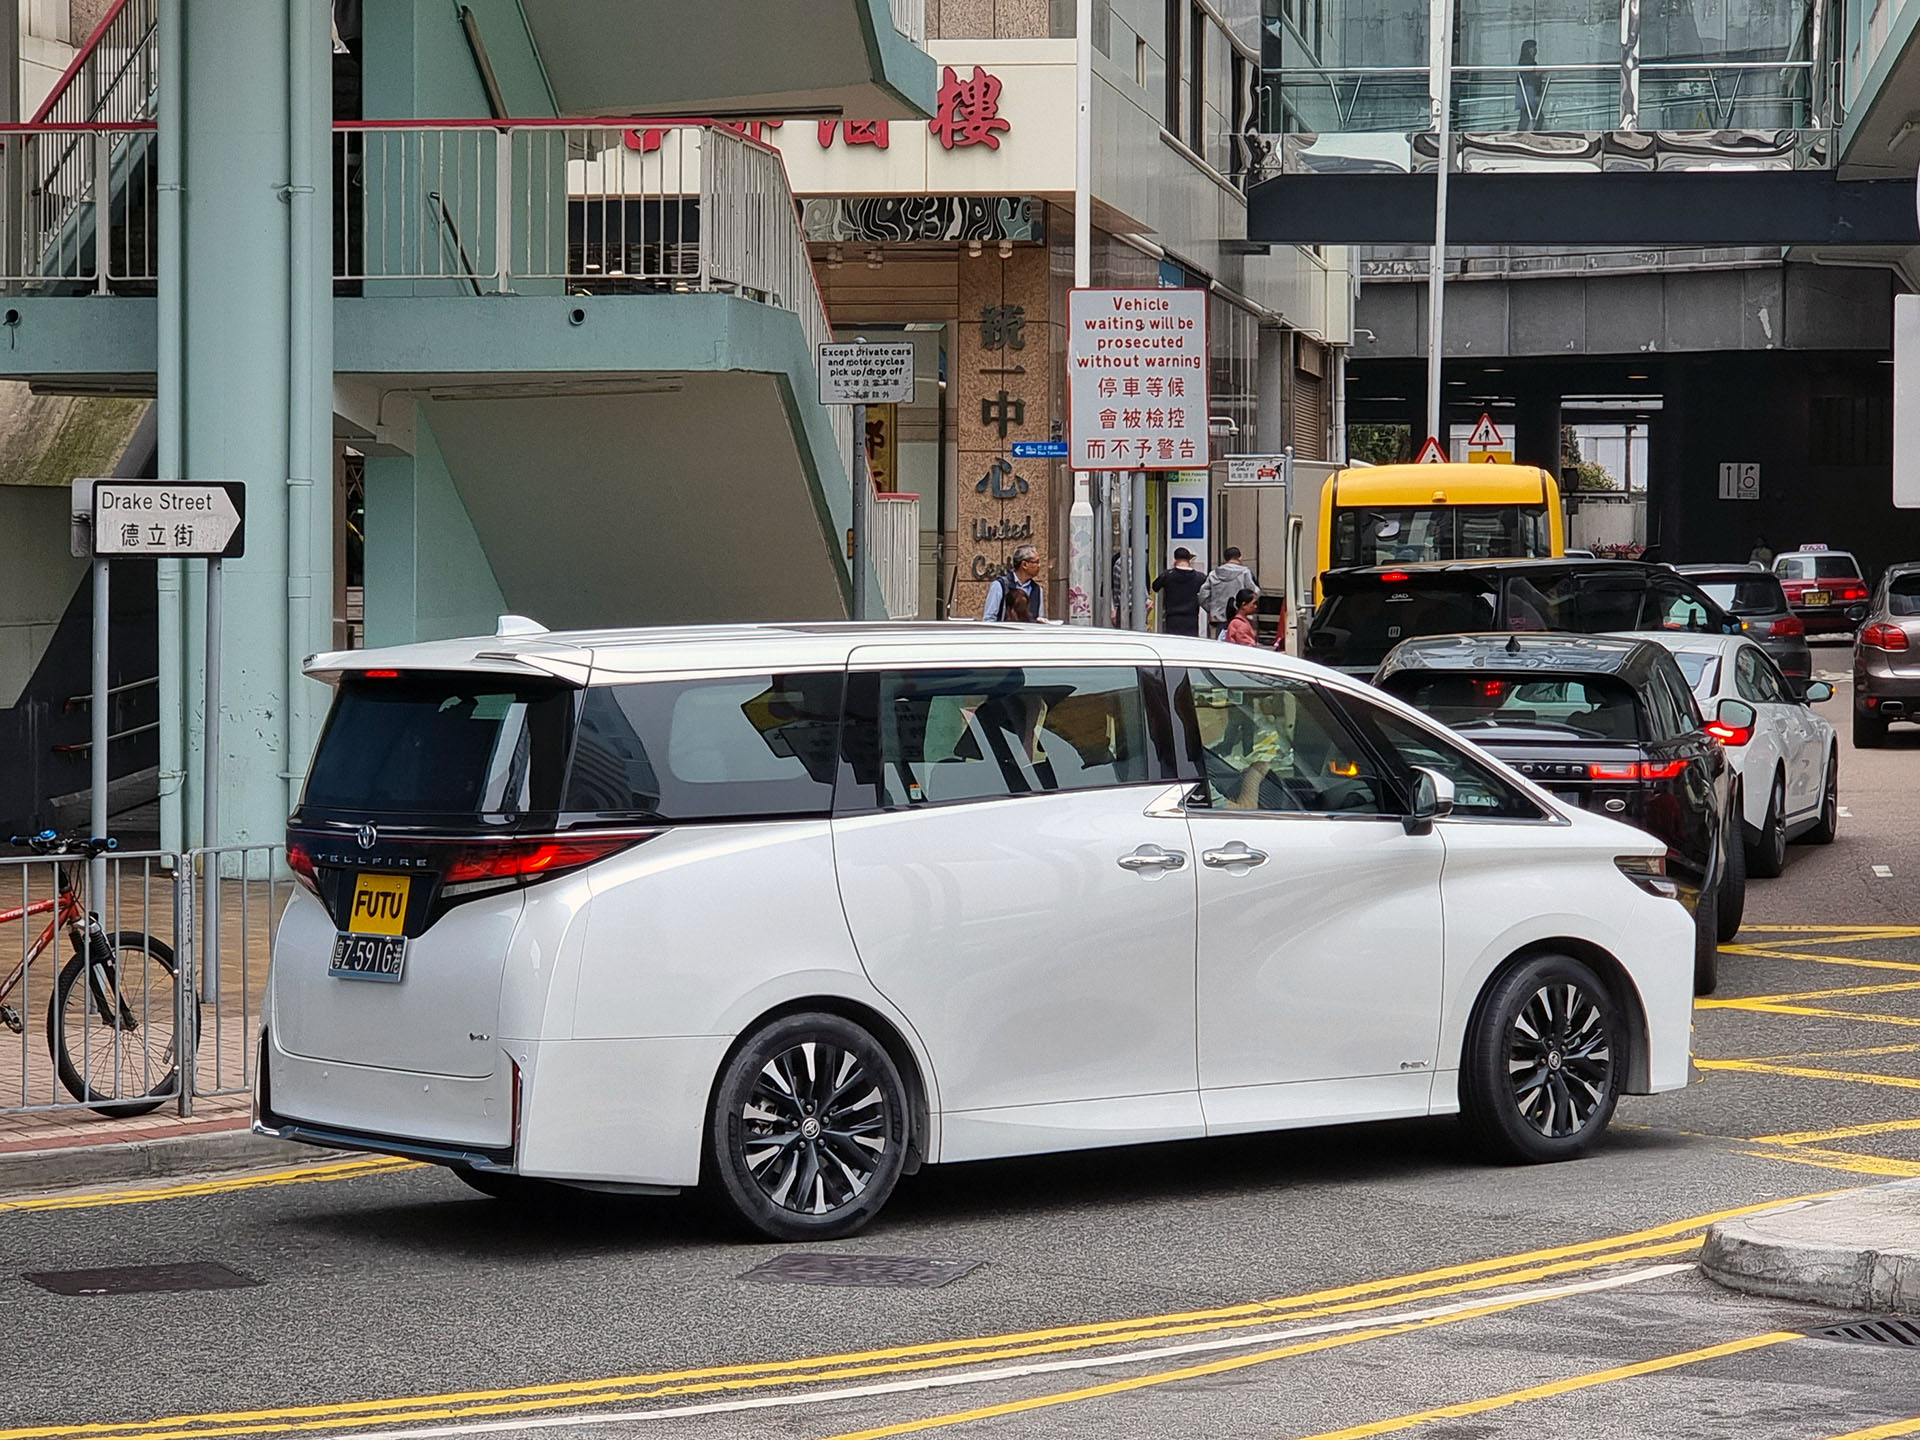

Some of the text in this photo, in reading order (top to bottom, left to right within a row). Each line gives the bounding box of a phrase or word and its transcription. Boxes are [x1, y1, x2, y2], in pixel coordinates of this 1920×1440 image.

[1113, 297, 1169, 311] Vehicle
[1085, 317, 1194, 331] waiting will be
[822, 348, 911, 357] Except private cars
[1098, 336, 1184, 351] prosecuted
[830, 368, 848, 377] pick
[851, 367, 887, 377] up/drop
[846, 359, 872, 367] motor
[874, 358, 905, 367] cycles
[1077, 355, 1201, 369] without warning
[1098, 377, 1185, 398] 停車等候
[975, 304, 1029, 499] 統一中心
[1099, 408, 1185, 429] 會被檢控
[1087, 438, 1195, 460] 而不予警告
[102, 491, 212, 510] Drake Street
[1177, 502, 1198, 534] P
[120, 523, 194, 547] 德立街
[972, 515, 1033, 542] United
[972, 555, 1014, 580] Cent
[316, 853, 428, 867] VELLFIRE
[355, 890, 404, 919] FUTU
